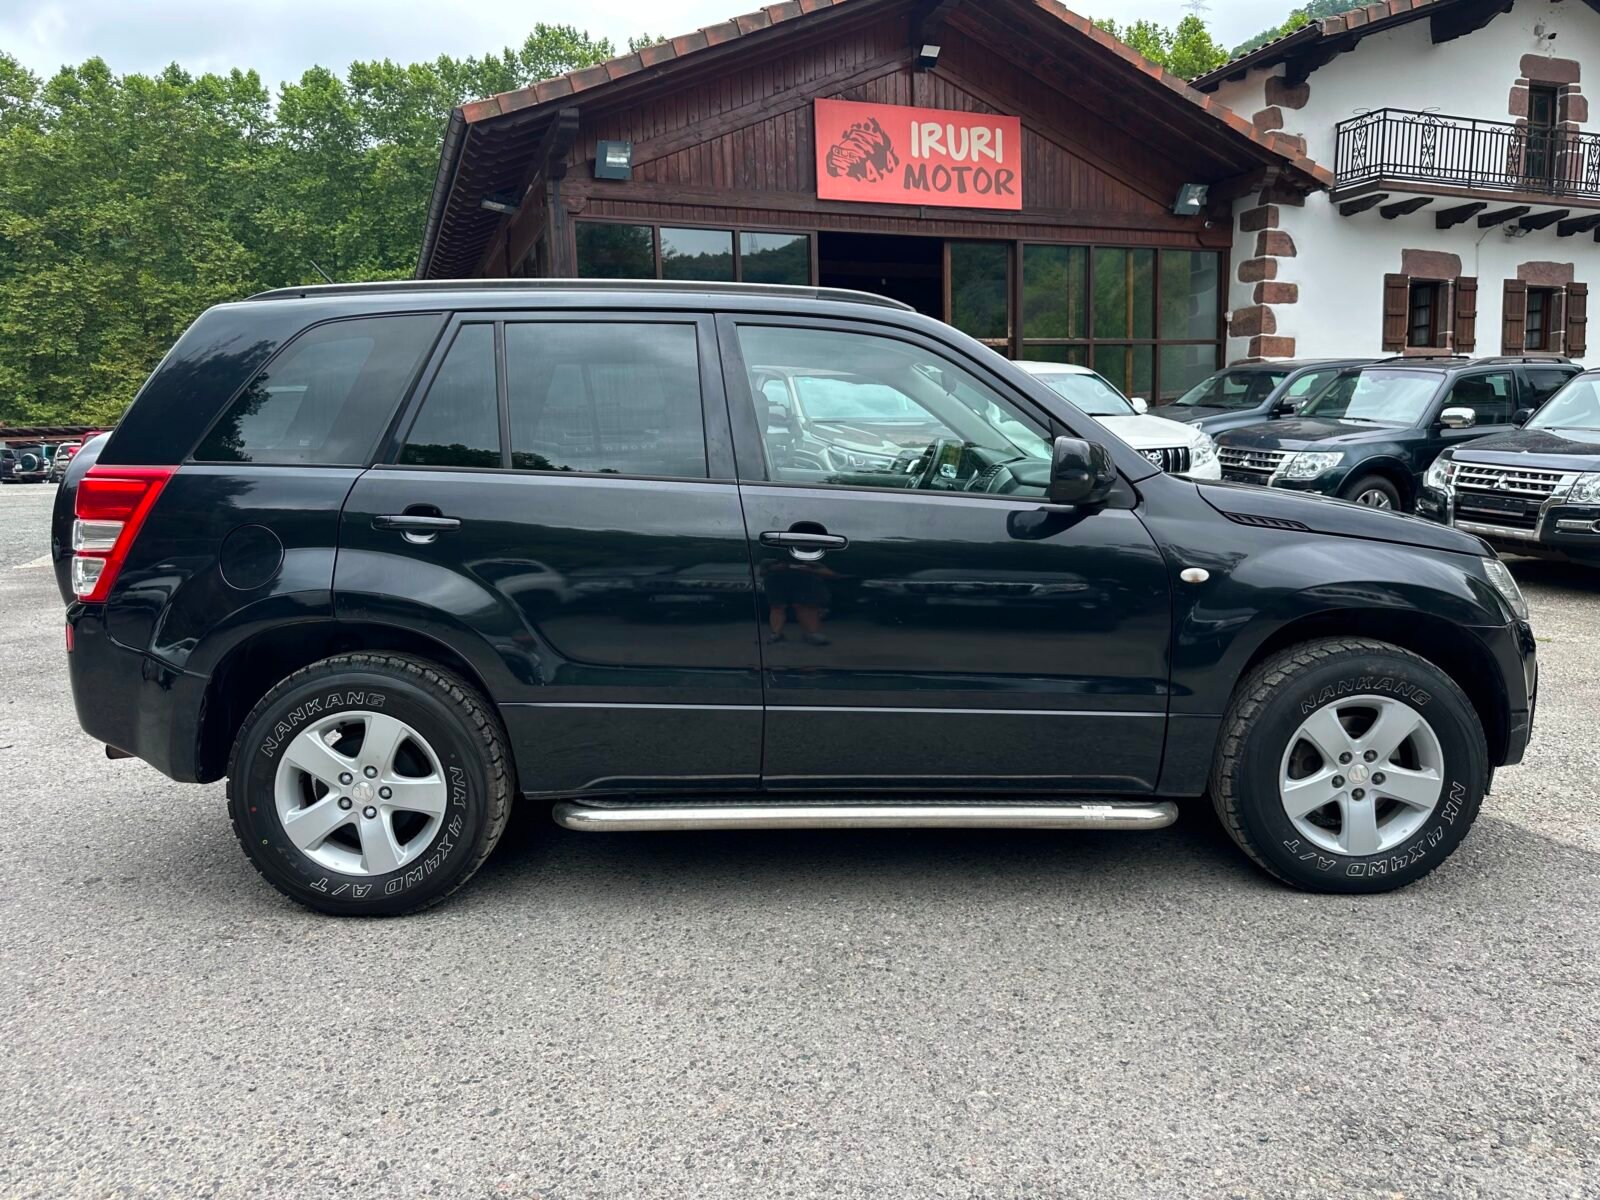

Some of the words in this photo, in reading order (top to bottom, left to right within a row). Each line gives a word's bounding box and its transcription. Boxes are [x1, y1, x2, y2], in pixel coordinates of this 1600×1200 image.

[911, 121, 1003, 163] IRURI
[903, 163, 1015, 195] MOTOR
[1300, 676, 1432, 714] NANKANG
[260, 692, 385, 757] NANKANG
[449, 766, 466, 809] NK
[1441, 781, 1466, 825] NK
[1283, 839, 1336, 871] A/T
[310, 877, 372, 898] A/T
